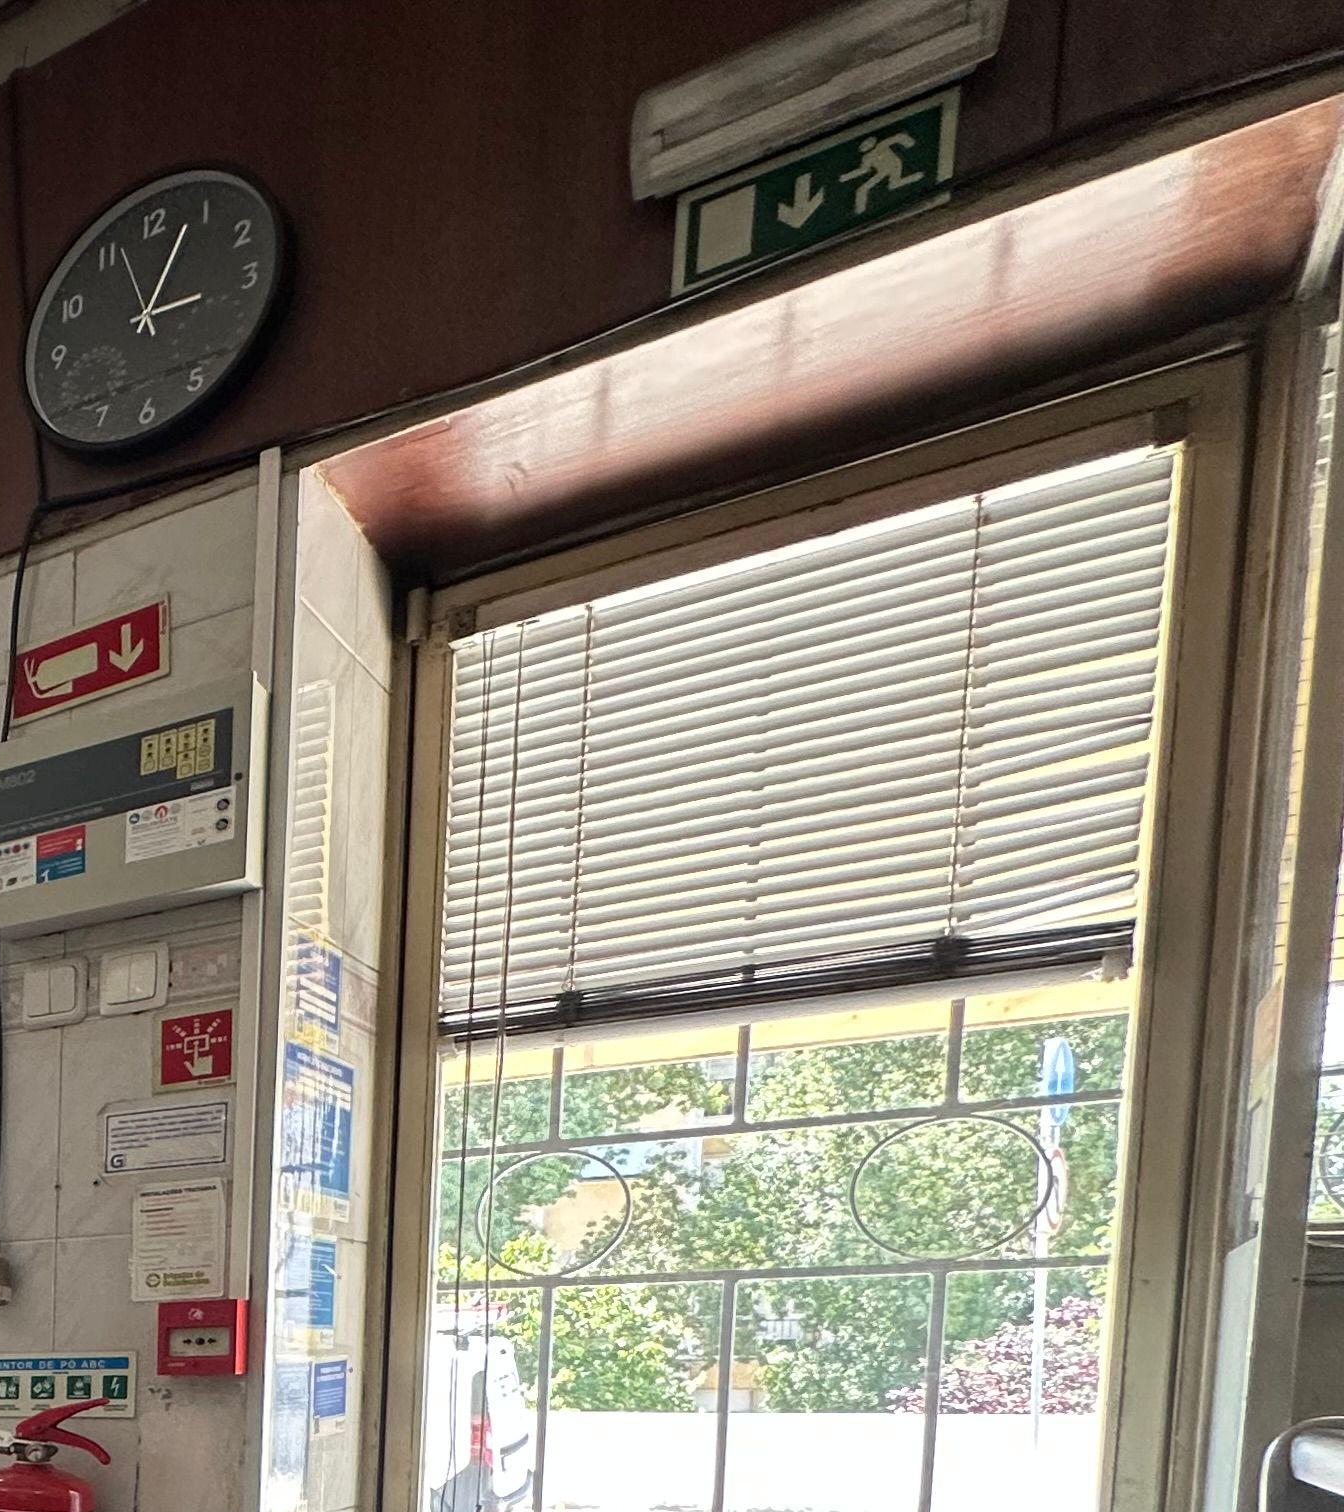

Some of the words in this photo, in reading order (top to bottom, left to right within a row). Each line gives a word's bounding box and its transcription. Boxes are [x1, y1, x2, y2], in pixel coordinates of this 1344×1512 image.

[142, 207, 167, 240] 12
[202, 199, 210, 225] 1
[232, 218, 252, 249] 2
[97, 241, 117, 272] 11
[240, 260, 259, 290] 3
[61, 293, 84, 324] 10
[50, 343, 67, 370] 9
[185, 366, 204, 392] 5
[95, 405, 110, 428] 7
[137, 397, 156, 425] 6
[38, 1360, 54, 1370] DE
[78, 1359, 106, 1369] ABC
